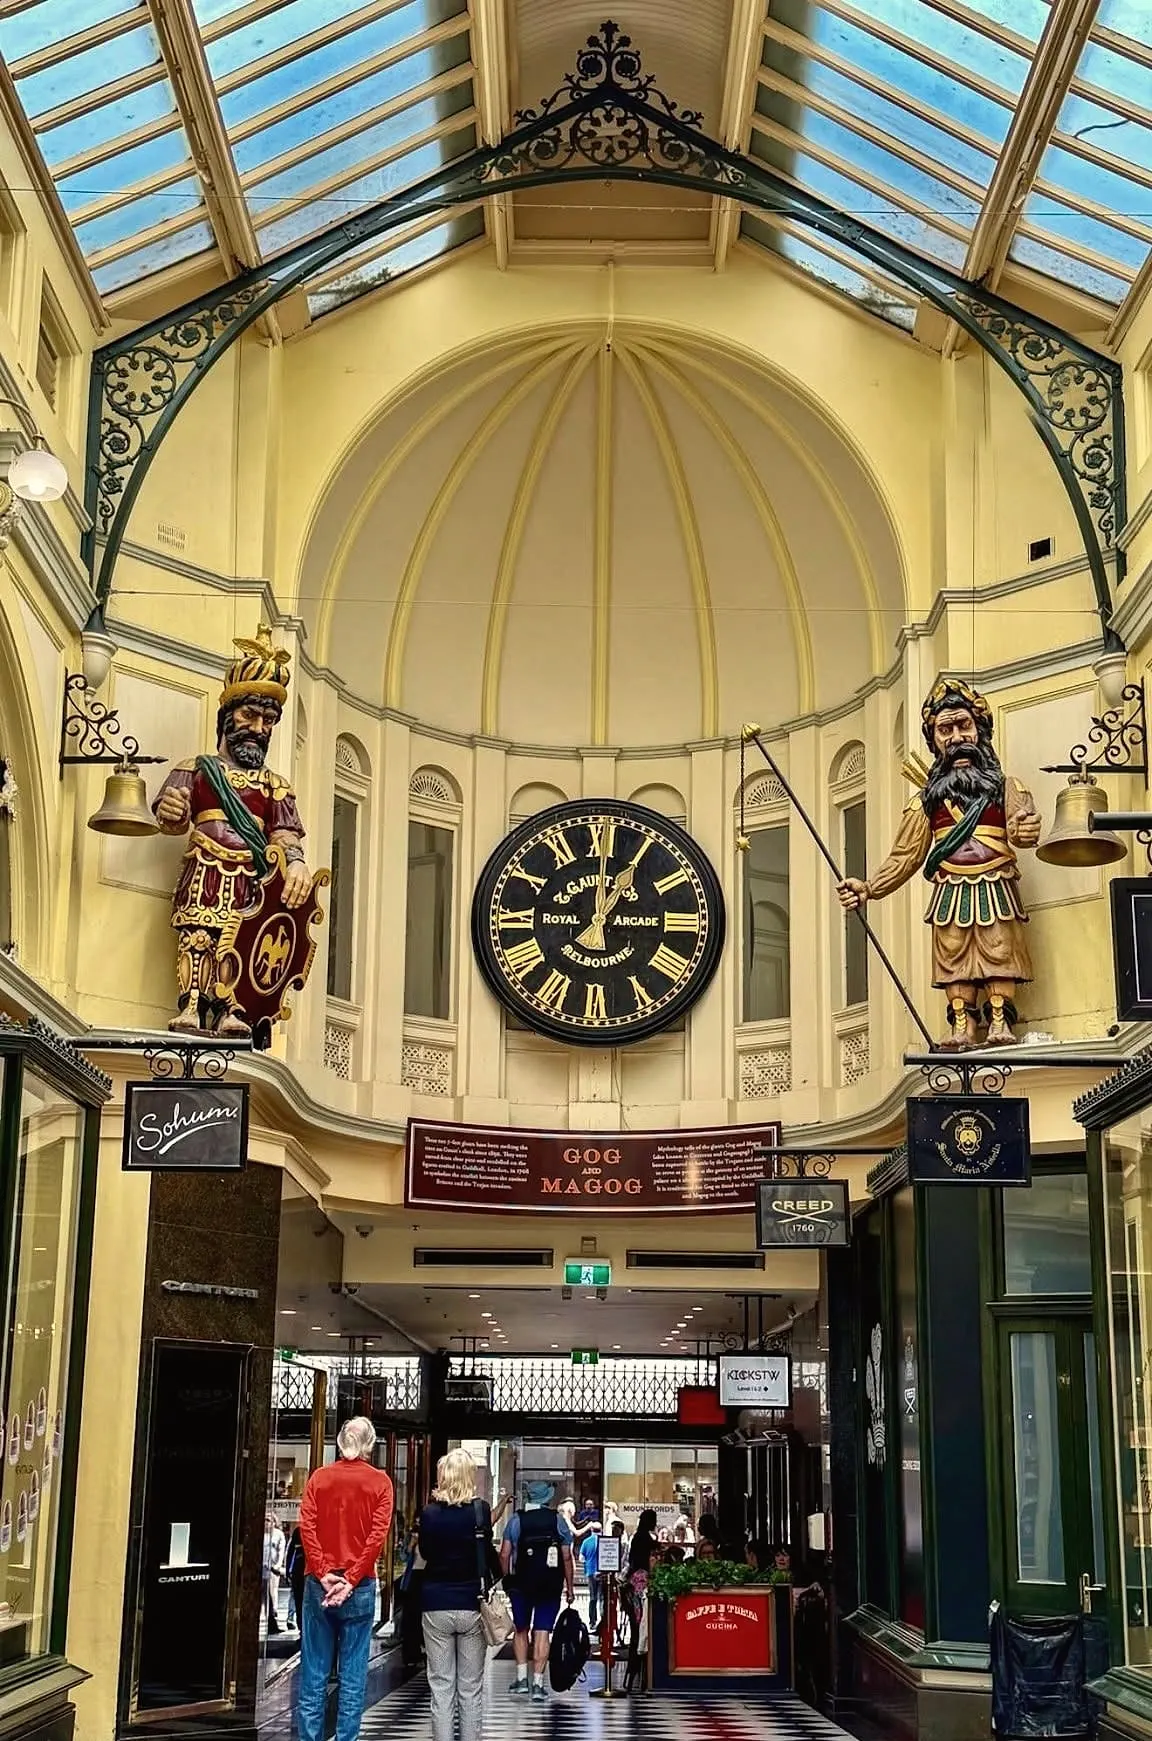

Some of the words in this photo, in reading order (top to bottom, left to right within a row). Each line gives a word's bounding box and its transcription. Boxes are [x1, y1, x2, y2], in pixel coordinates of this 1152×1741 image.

[542, 913, 580, 924] ROYAL
[613, 914, 660, 926] ARCADE
[563, 1148, 622, 1164] GOG
[541, 1178, 642, 1194] MAGOG
[772, 1200, 834, 1213] CREED
[792, 1224, 814, 1232] 1760
[158, 1574, 210, 1583] CANTURI
